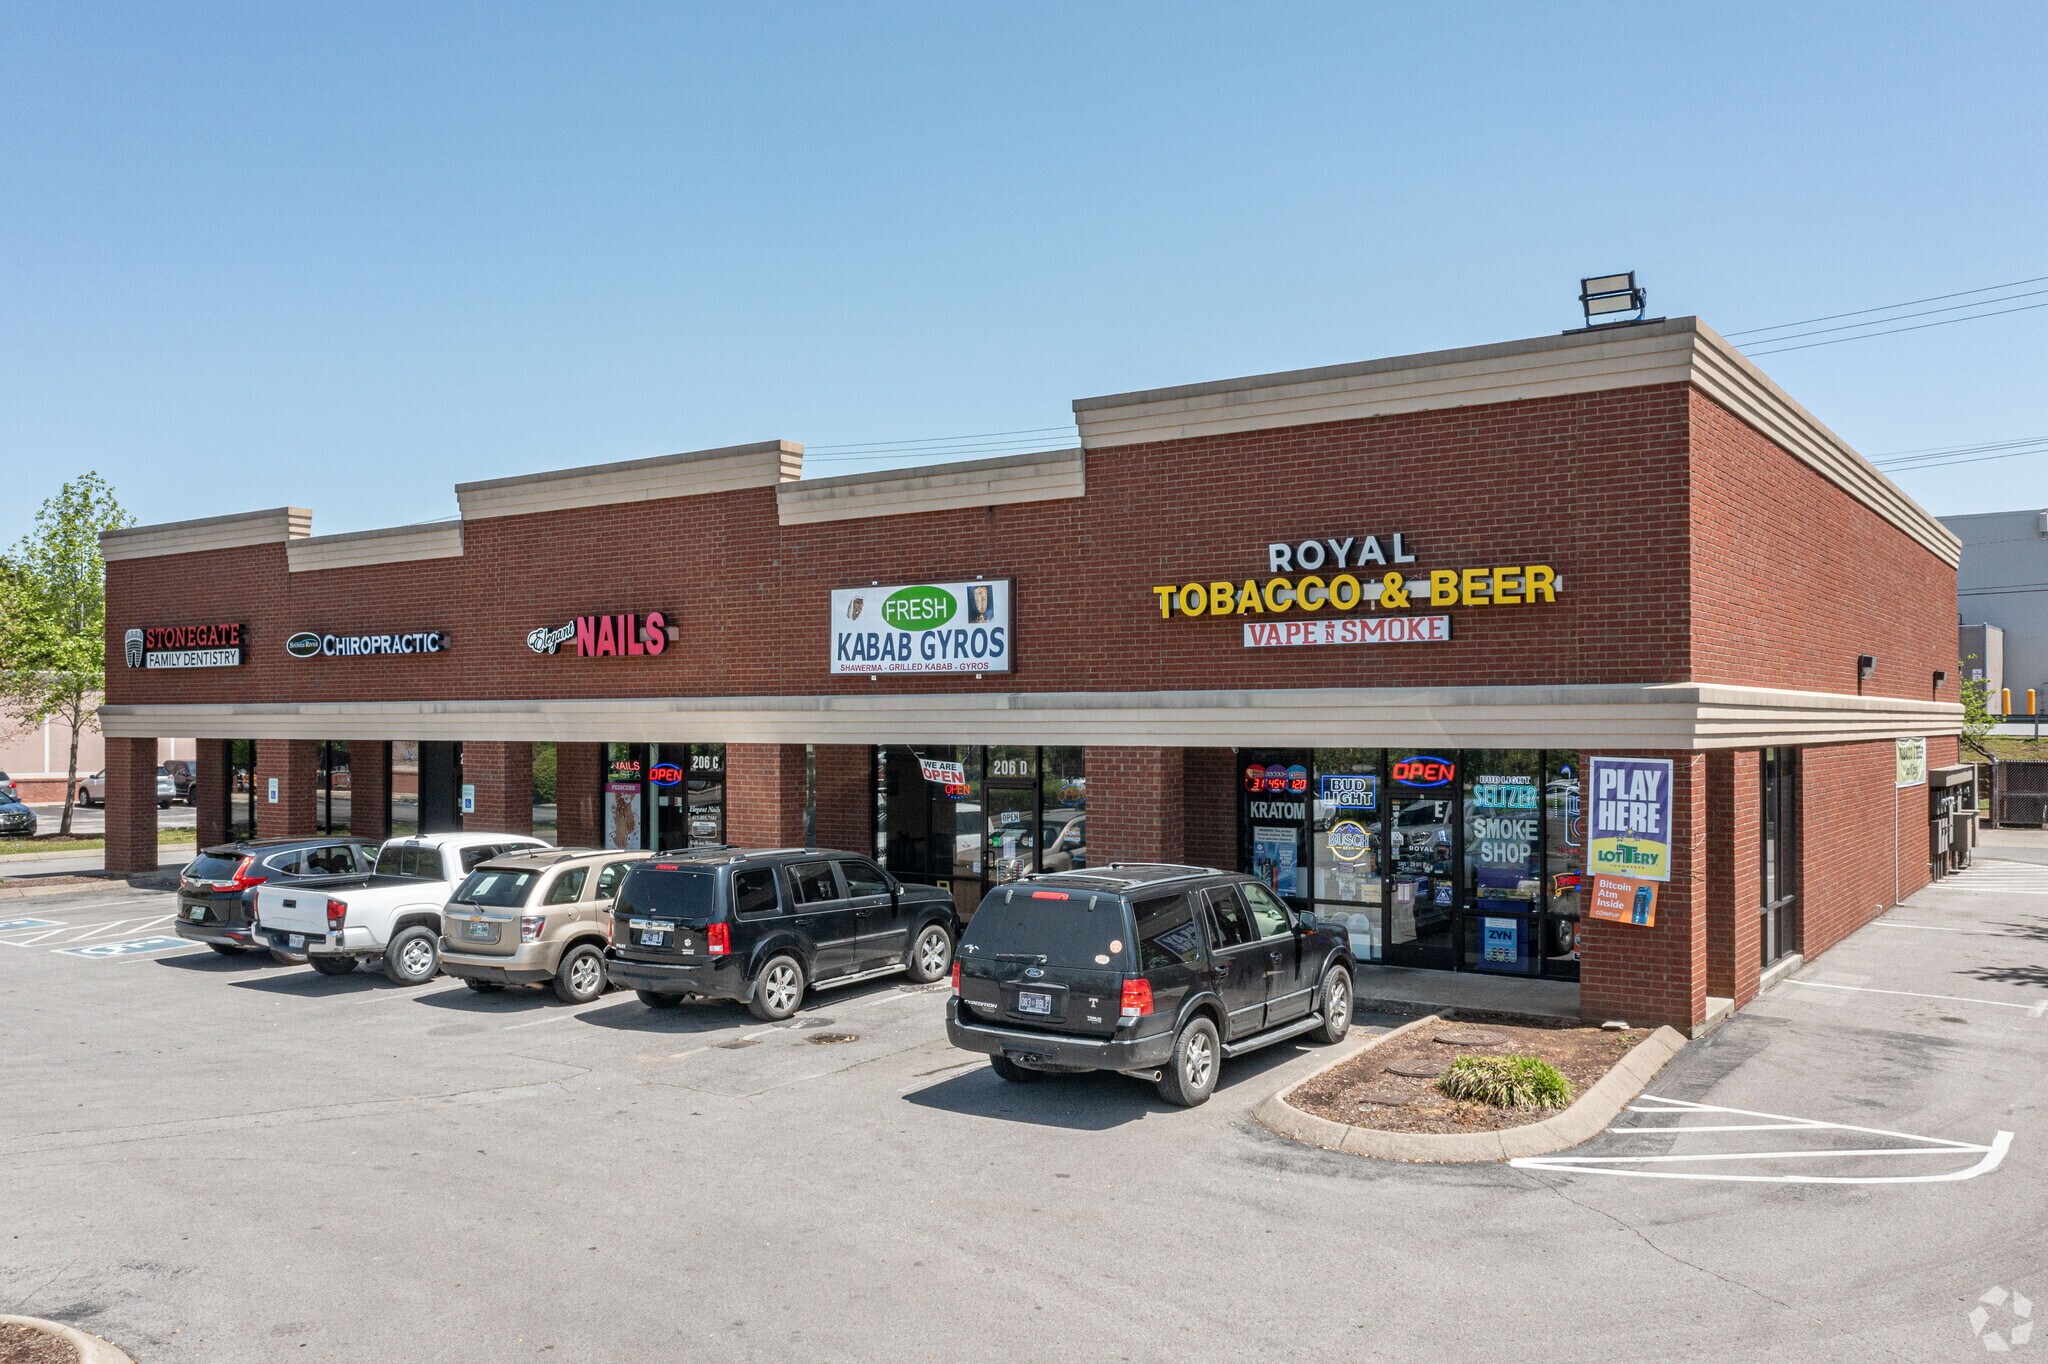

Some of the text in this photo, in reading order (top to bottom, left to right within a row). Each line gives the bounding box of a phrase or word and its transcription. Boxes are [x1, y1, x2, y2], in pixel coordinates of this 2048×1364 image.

[1268, 533, 1416, 573] ROYAL
[1153, 565, 1556, 619] TOBACCO & BEER
[885, 597, 947, 622] FRESH
[146, 623, 240, 648] STONEGATE
[527, 620, 575, 655] Elegant
[577, 611, 665, 657] NAILS
[1248, 621, 1318, 646] VAPE
[1341, 617, 1444, 643] SMOKE
[322, 633, 440, 656] CHIROPRACTIC
[837, 626, 1005, 661] KABAB GYROS
[149, 650, 237, 667] FAMILY DENTISTRY
[840, 664, 883, 672] SHAWERMA
[888, 663, 923, 671] GRILLED
[959, 662, 989, 670] GYROS
[611, 761, 641, 771] NAILS
[692, 756, 719, 770] 206 C
[924, 760, 937, 769] WE
[993, 760, 1027, 775] 206 D
[620, 770, 641, 779] SPA
[649, 768, 682, 782] OPEN
[923, 767, 964, 783] OPEN
[1392, 763, 1455, 781] OPEN
[1268, 779, 1286, 789] 454
[1292, 780, 1306, 790] 120
[1331, 778, 1366, 792] BUD
[1480, 776, 1531, 784] BUD LIGHT
[1600, 768, 1662, 801] PLAY
[944, 784, 971, 795] OPEN
[1473, 784, 1538, 809] SELTZER
[1324, 792, 1373, 806] LIGHT
[690, 805, 721, 814] Elegant Nails
[1002, 812, 1019, 822] OPEN
[1250, 801, 1306, 820] KRATOM
[1598, 800, 1661, 834] HERE
[1473, 818, 1539, 841] SMOKE
[1328, 833, 1370, 848] BUSCH
[1481, 841, 1531, 864] SHOP
[1598, 843, 1660, 866] LOTTERY
[1599, 880, 1632, 892] Bitcoin
[1598, 889, 1618, 899] Atm
[1597, 898, 1625, 910] Inside
[1489, 930, 1512, 941] ZYN
